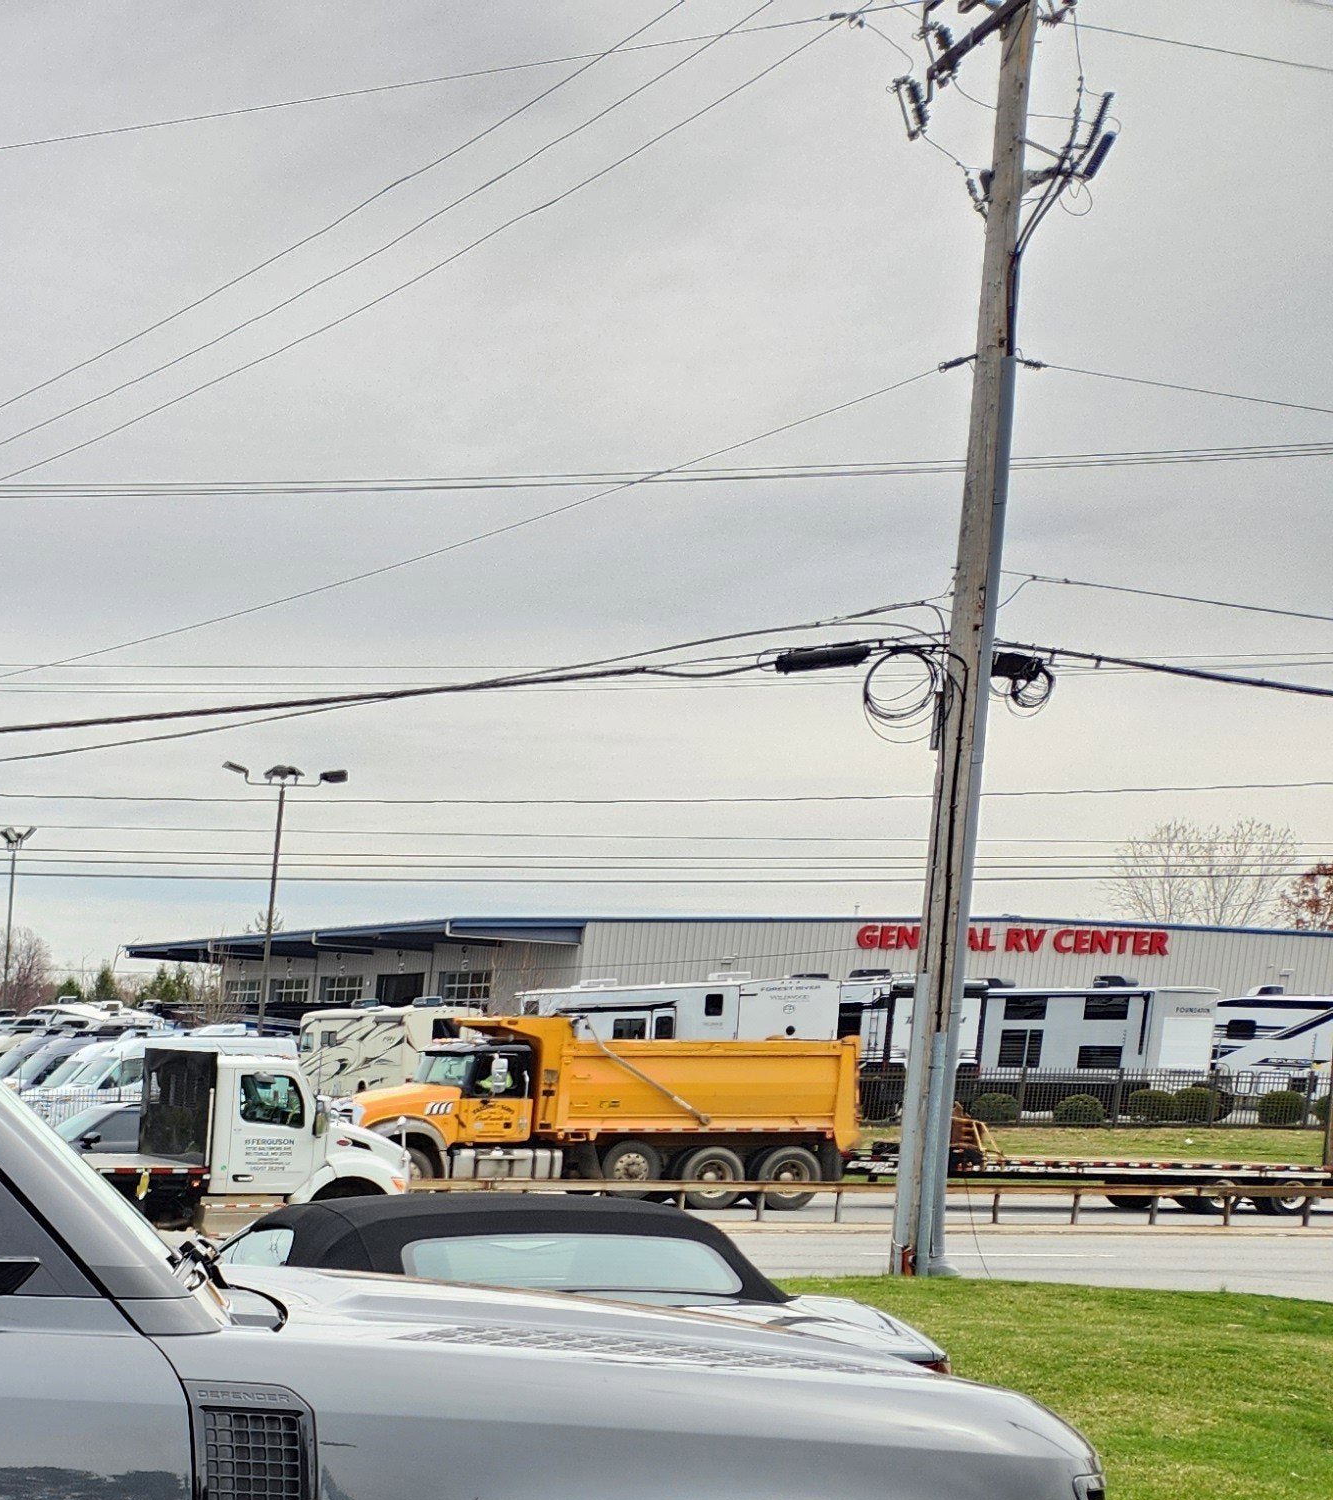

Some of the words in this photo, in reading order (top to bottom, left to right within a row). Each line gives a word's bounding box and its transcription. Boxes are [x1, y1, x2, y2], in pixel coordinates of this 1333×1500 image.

[856, 925, 997, 952] GENAL
[1004, 927, 1047, 953] RV
[1052, 929, 1170, 956] CENTER
[252, 1138, 295, 1146] FERGUSON
[197, 1389, 290, 1402] DEFENDER
